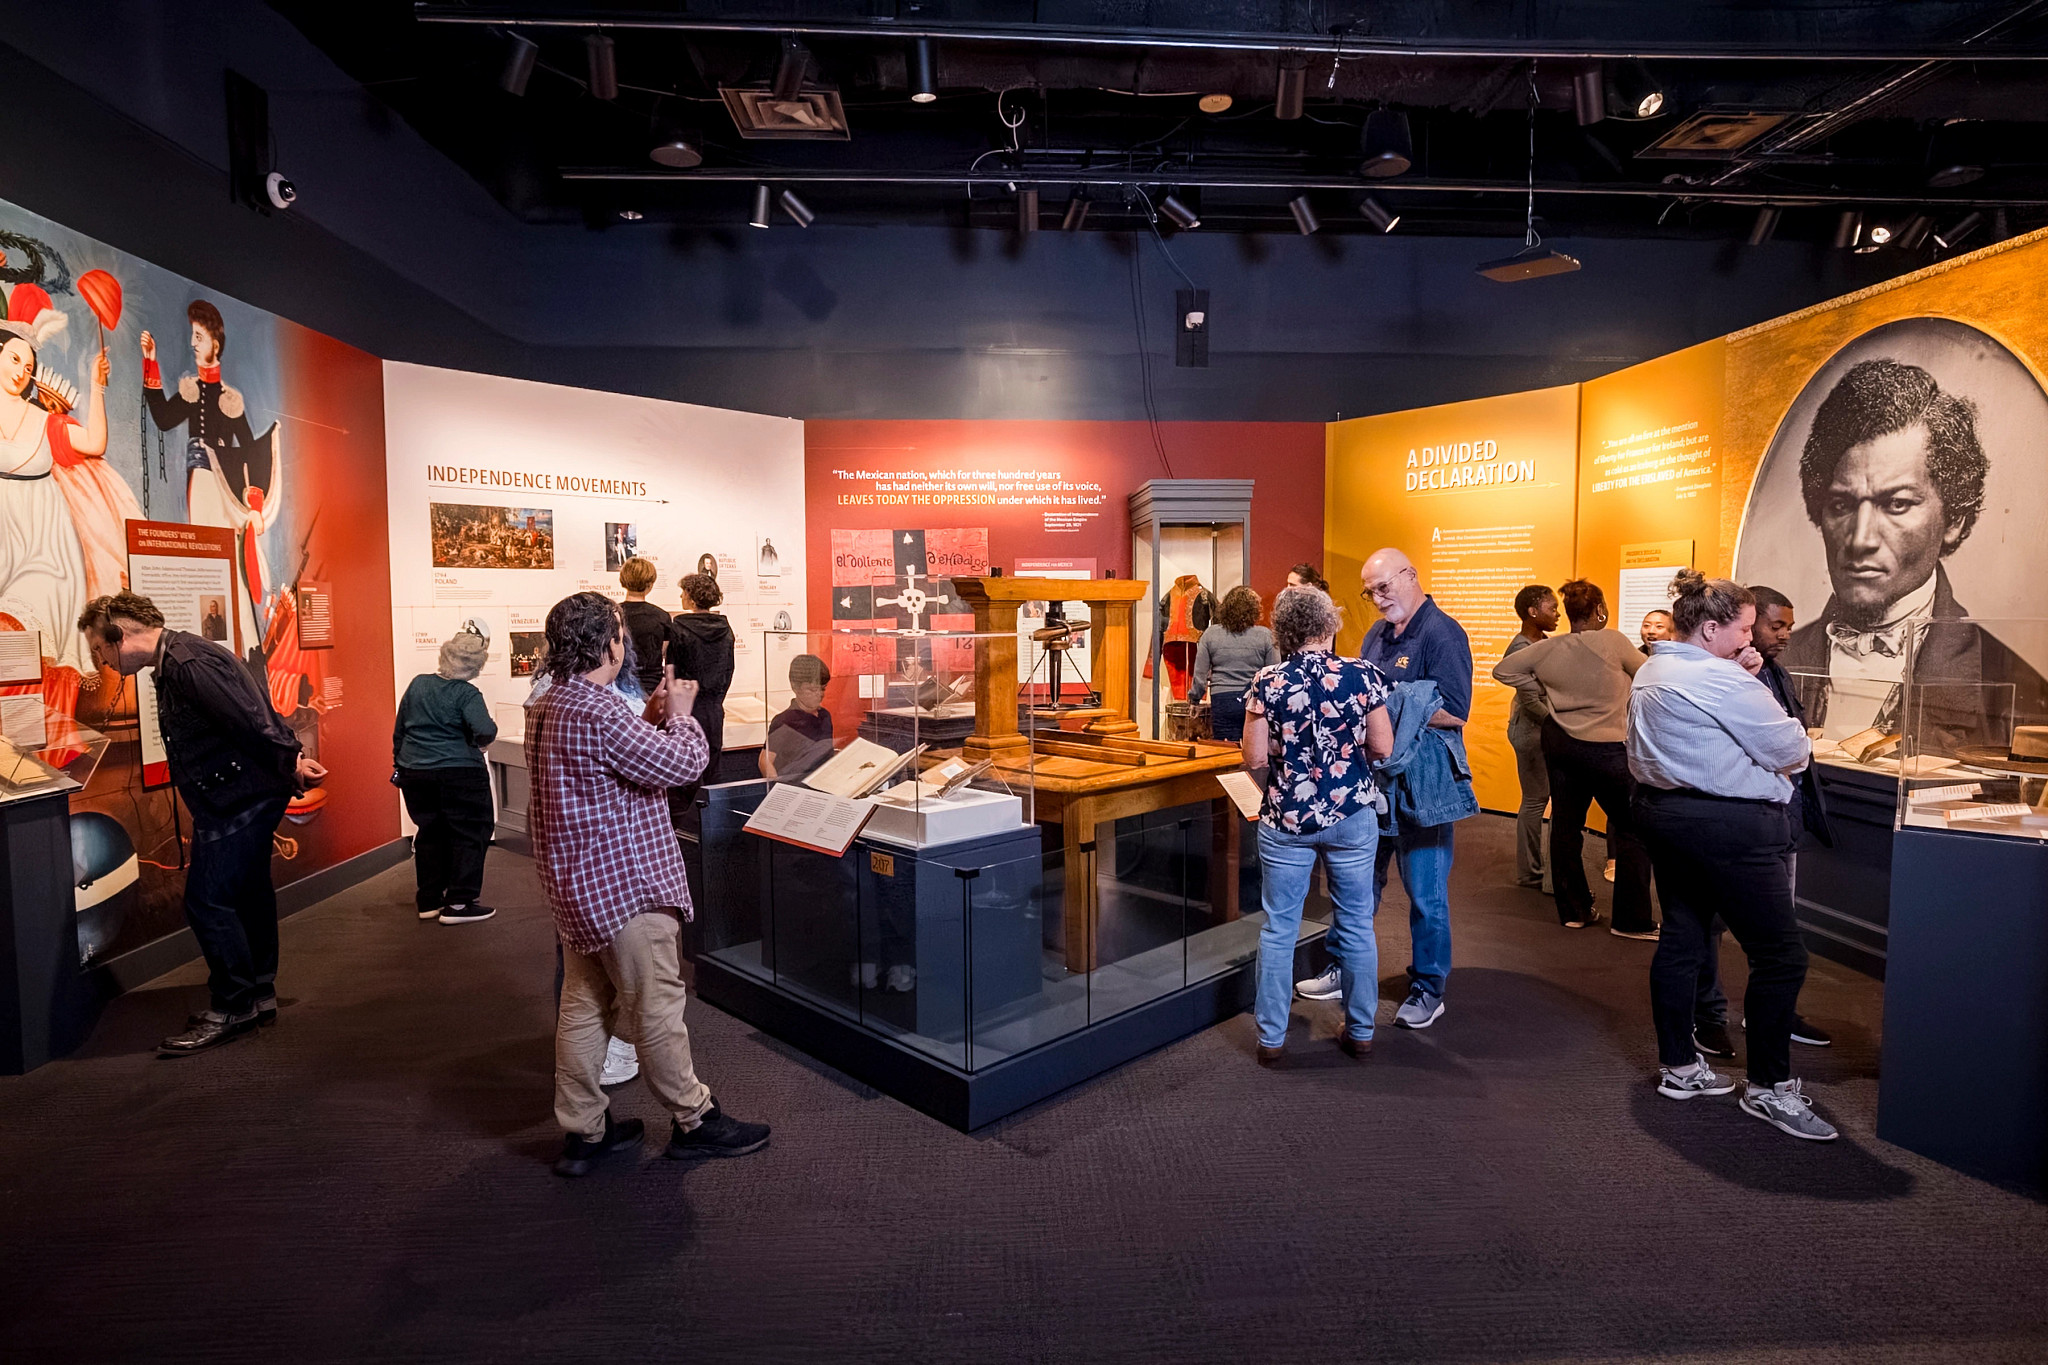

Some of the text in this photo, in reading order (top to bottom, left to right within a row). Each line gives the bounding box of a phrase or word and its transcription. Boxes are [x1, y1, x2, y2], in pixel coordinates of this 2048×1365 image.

[1661, 427, 1671, 436] the
[1672, 421, 1698, 433] mention
[1662, 436, 1685, 450] Ireland;
[1686, 435, 1697, 446] but
[1698, 434, 1710, 443] are
[1406, 440, 1498, 468] A DIVIDED
[1666, 455, 1676, 464] the
[1677, 450, 1702, 463] thought
[1703, 446, 1712, 458] of
[427, 465, 646, 496] INDEPENDENCE MOVEMENTS
[856, 470, 895, 480] Mexican
[896, 470, 928, 481] nation,
[929, 470, 956, 480] which
[957, 470, 970, 480] for
[972, 470, 996, 480] three
[998, 470, 1035, 480] hundred
[1036, 471, 1061, 481] years
[1406, 459, 1536, 492] DECLARATION
[1592, 480, 1614, 493] LIBERTY
[1615, 478, 1627, 488] FOR
[1629, 476, 1640, 486] THE
[1641, 469, 1675, 485] ENSLAVED
[1676, 469, 1683, 478] of
[875, 481, 891, 491] has
[893, 481, 910, 491] had
[911, 481, 944, 491] neither
[945, 482, 956, 491] its
[979, 481, 998, 492] will,
[1015, 481, 1034, 491] free
[1052, 481, 1063, 491] of
[1063, 482, 1074, 491] its
[1075, 482, 1102, 492] voice,
[838, 494, 874, 505] LEAVES
[876, 494, 910, 505] TODAY
[912, 494, 930, 505] THE
[933, 494, 996, 505] OPPRESSION
[997, 495, 1023, 505] under
[1025, 494, 1052, 505] which
[1053, 495, 1060, 505] it
[1061, 495, 1077, 505] has
[146, 540, 187, 549] INTERNATIONAL
[189, 542, 222, 551] REVOLUTIONS
[873, 856, 890, 872] 207
